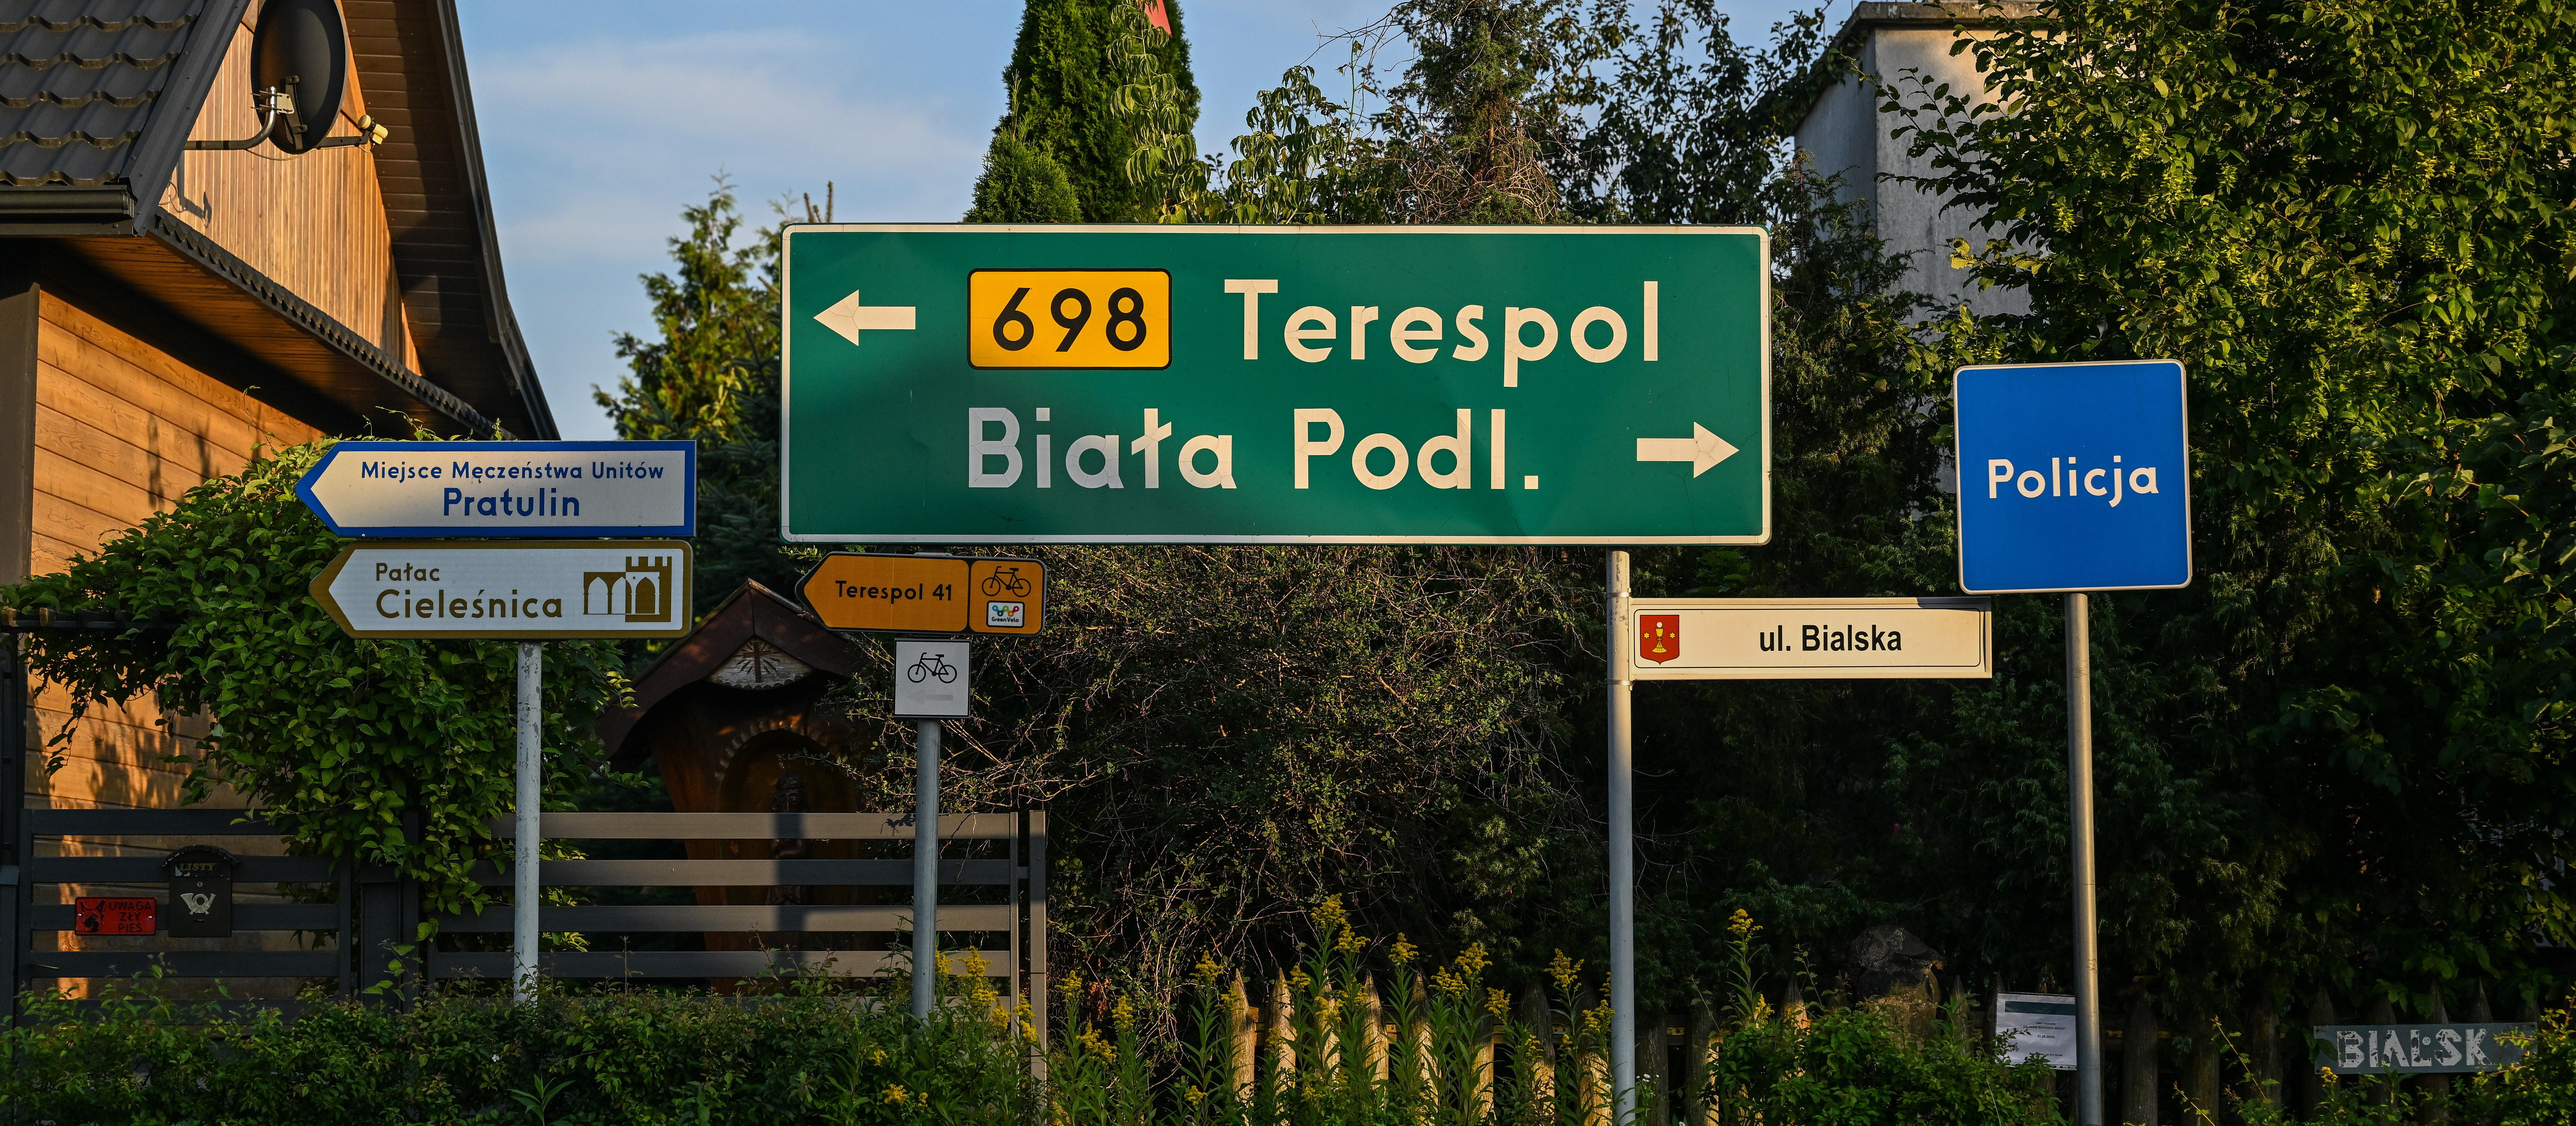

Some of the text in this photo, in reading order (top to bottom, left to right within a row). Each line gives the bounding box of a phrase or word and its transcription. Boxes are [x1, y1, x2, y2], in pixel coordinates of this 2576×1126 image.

[992, 287, 1147, 352] 698
[1224, 279, 1658, 388] Terespol
[968, 407, 1539, 490] Biała Podl.
[362, 461, 664, 483] Miejsce Męczeństwa Unitów
[1988, 455, 2159, 508] Policja
[444, 487, 580, 517] Pratulin
[376, 562, 440, 582] Pałac
[376, 589, 562, 619] Cieleśnica
[835, 580, 952, 605] Terespol 41
[1759, 624, 1902, 652] ul. Bialska
[179, 863, 217, 871] LISTY
[109, 901, 152, 910] UWAGA
[119, 912, 141, 921] ZŁY
[118, 923, 142, 932] PIES
